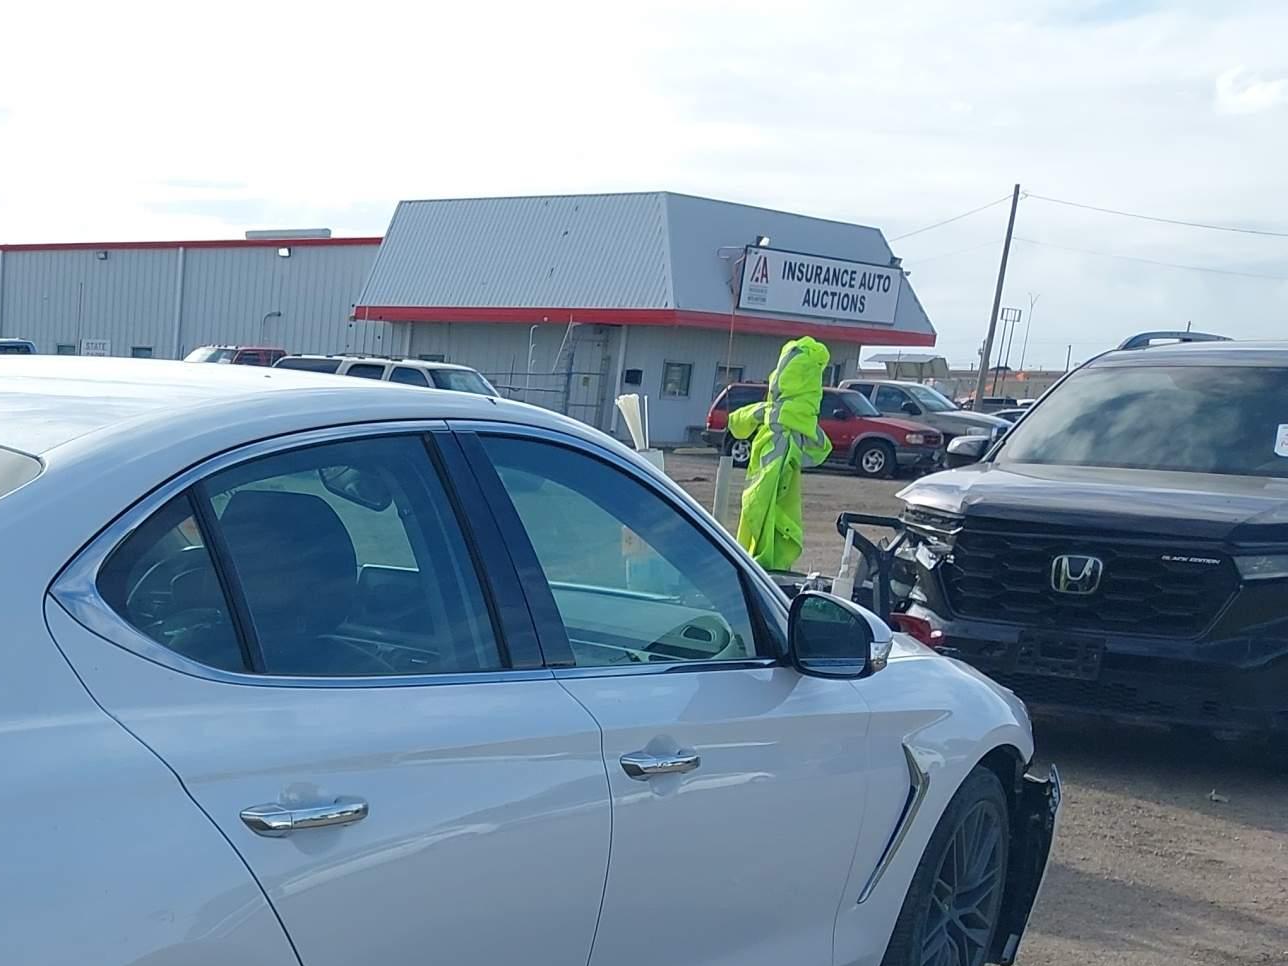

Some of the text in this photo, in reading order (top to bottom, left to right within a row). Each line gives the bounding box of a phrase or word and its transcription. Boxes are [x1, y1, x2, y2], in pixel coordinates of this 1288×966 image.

[782, 260, 891, 293] INSURANCE AUTO
[802, 288, 865, 314] AUCTIONS
